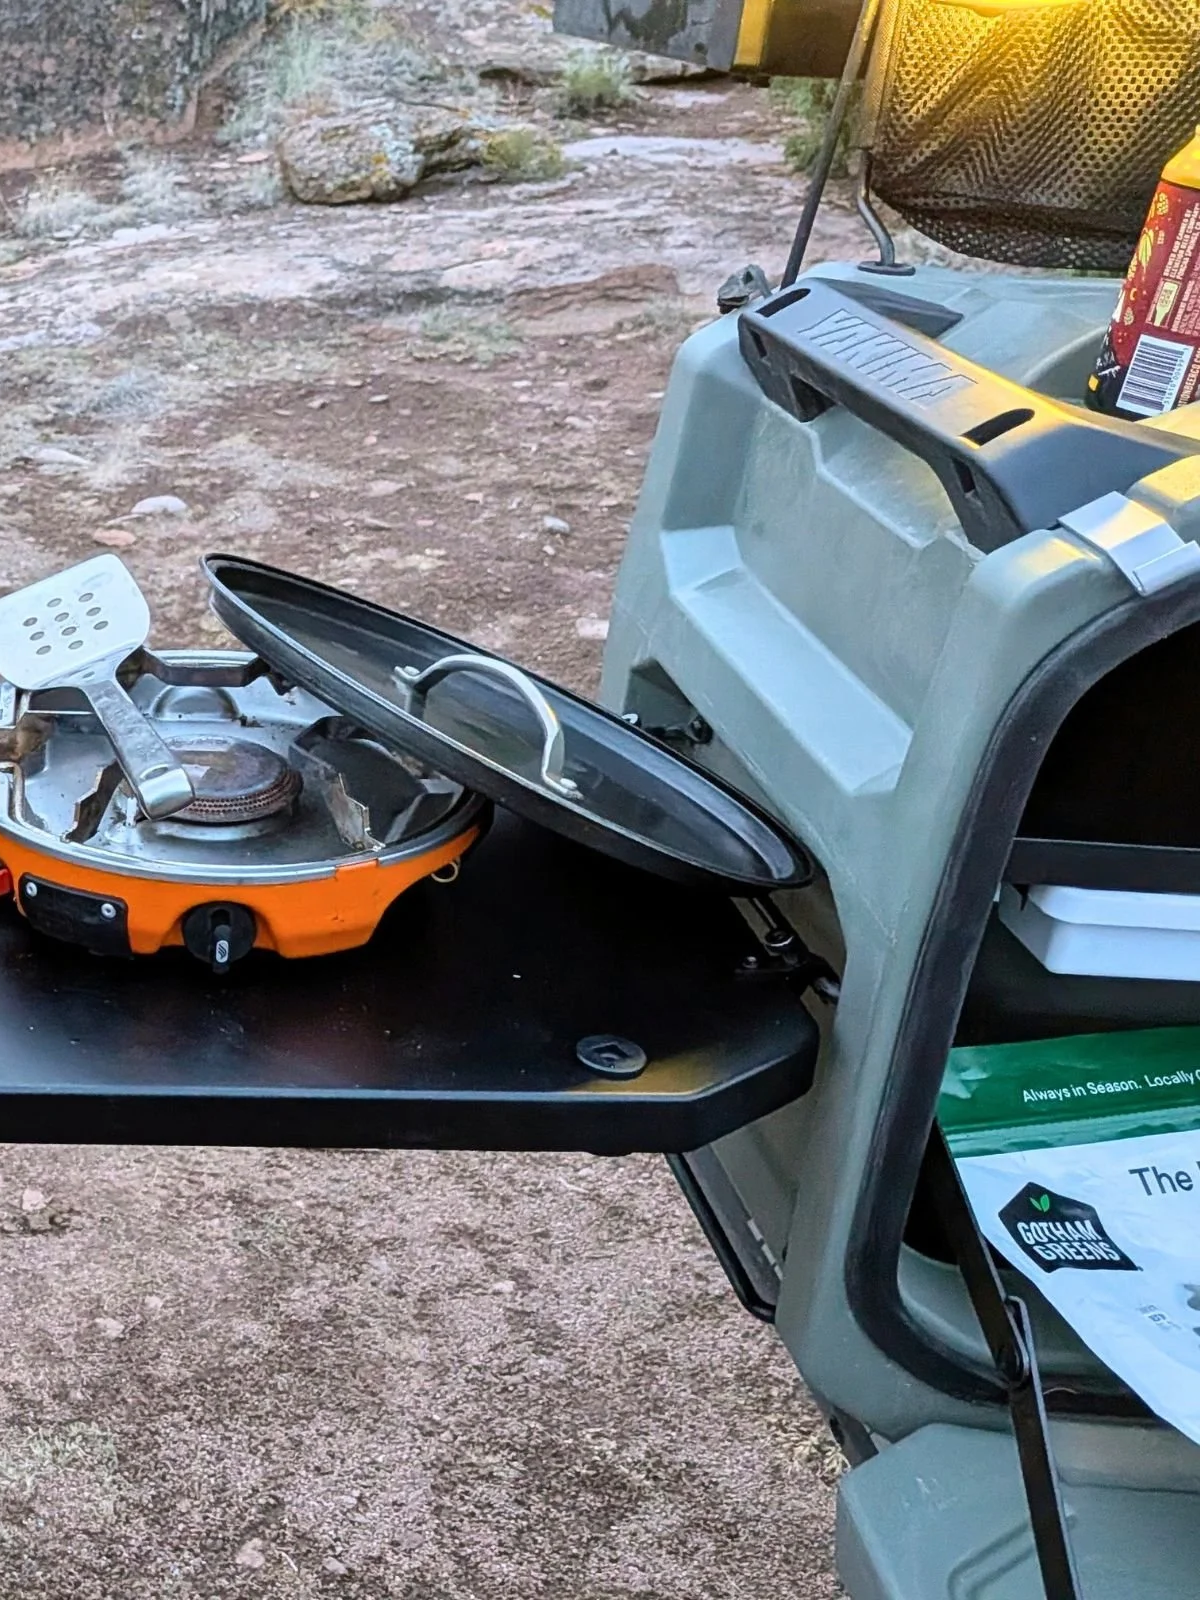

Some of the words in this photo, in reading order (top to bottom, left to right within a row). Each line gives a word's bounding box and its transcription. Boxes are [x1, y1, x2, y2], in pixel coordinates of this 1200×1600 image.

[796, 307, 979, 401] YAKIMA
[1022, 1087, 1071, 1103] Always
[1070, 1084, 1087, 1097] in
[1087, 1079, 1143, 1096] Season.
[1144, 1070, 1196, 1088] Locally
[1127, 1165, 1195, 1197] The
[1016, 1219, 1103, 1246] GOTHAM
[1032, 1241, 1121, 1261] GREENS
